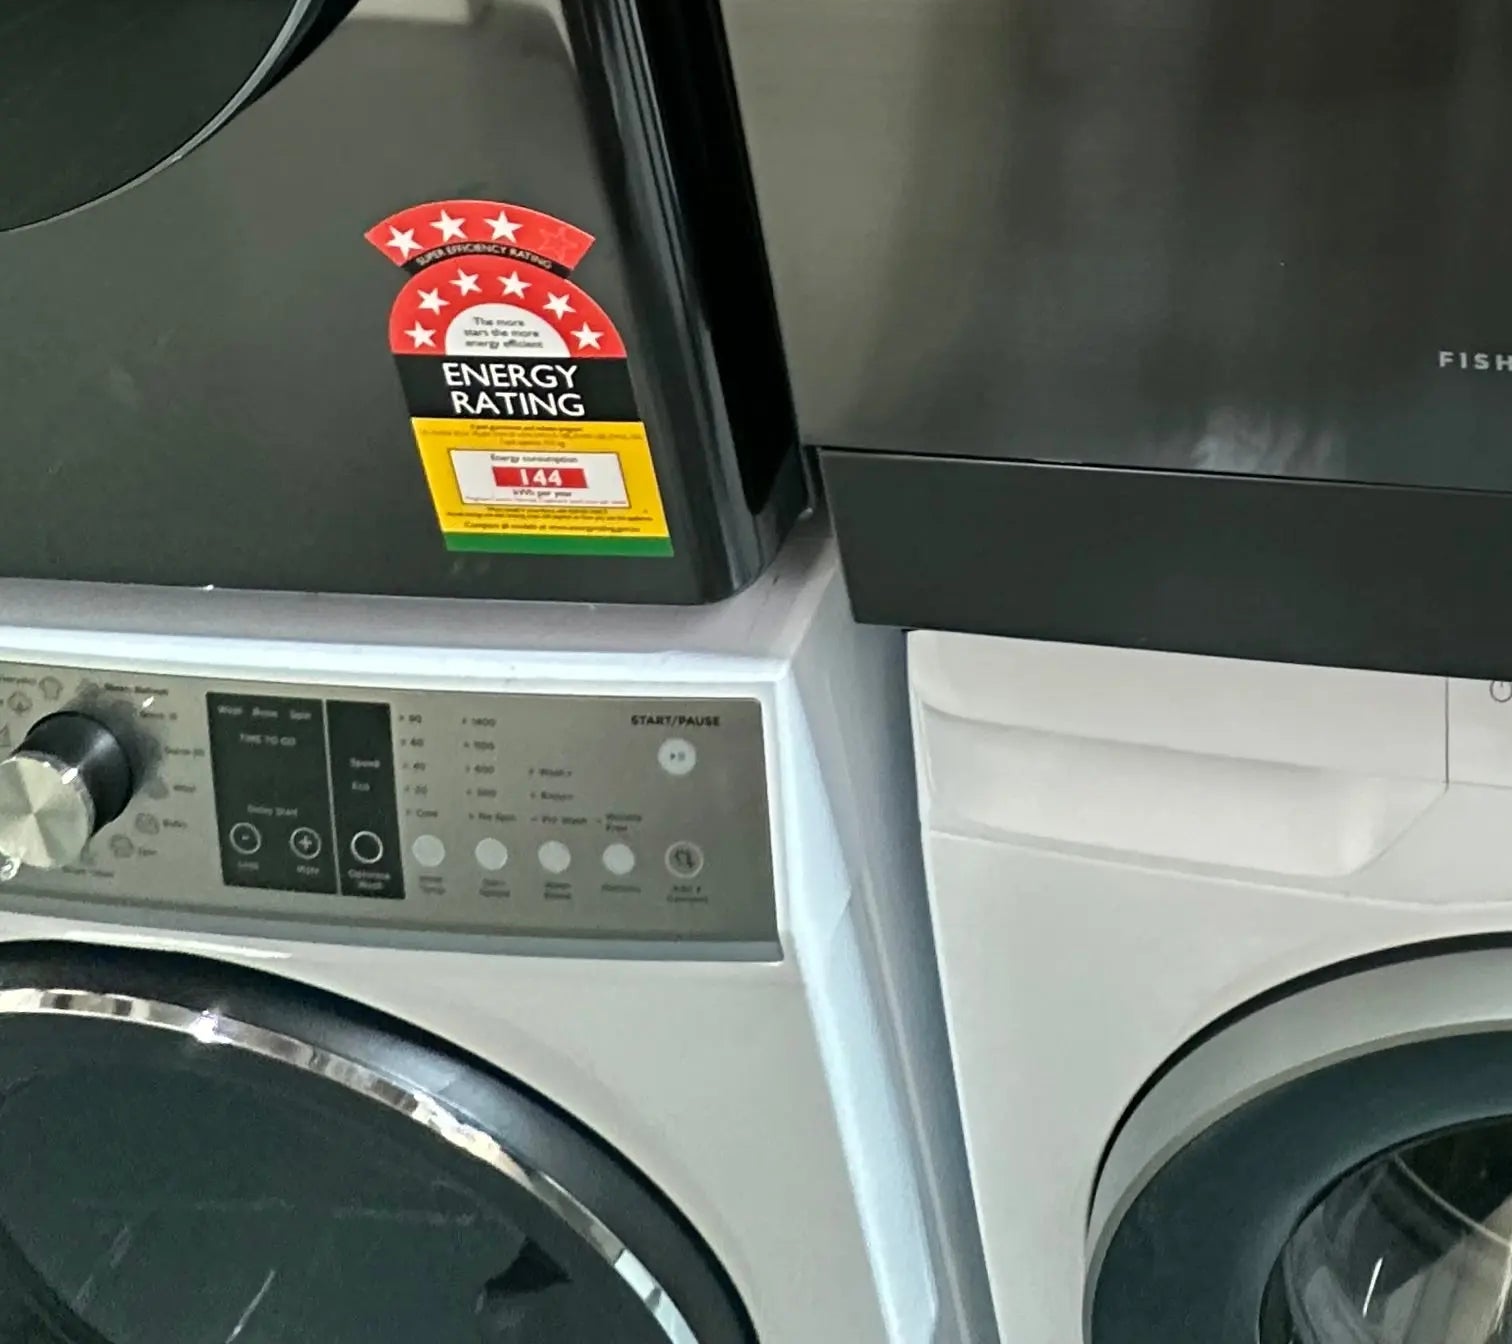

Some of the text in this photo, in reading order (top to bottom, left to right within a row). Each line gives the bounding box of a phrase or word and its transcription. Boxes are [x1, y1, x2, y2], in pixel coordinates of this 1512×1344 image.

[509, 247, 553, 270] RATING
[473, 316, 494, 326] The
[442, 361, 578, 389] ENERGY
[450, 390, 585, 417] RATING
[519, 468, 563, 487] 144
[630, 714, 721, 727] START/PAUSE
